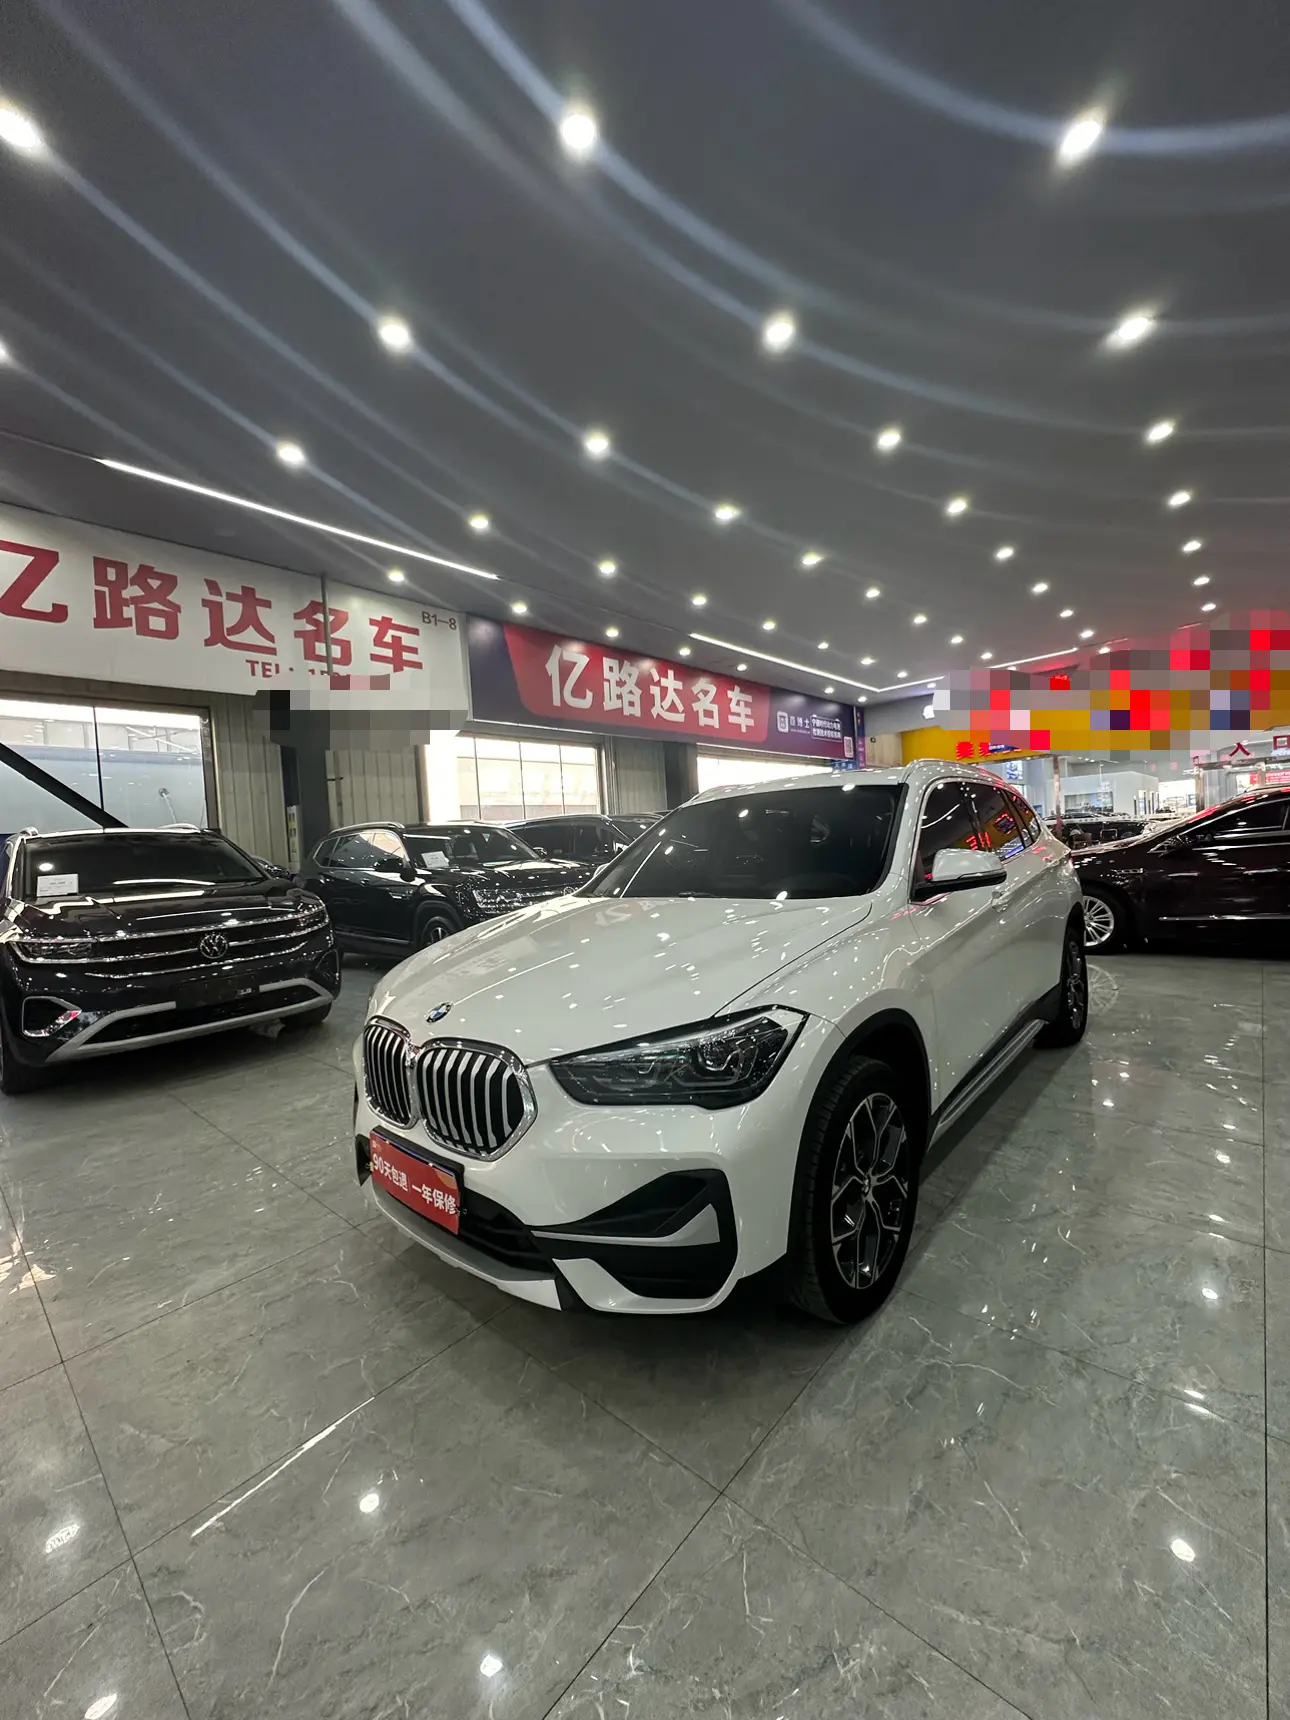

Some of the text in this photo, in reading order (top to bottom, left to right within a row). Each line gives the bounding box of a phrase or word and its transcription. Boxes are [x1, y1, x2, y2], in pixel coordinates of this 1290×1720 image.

[545, 644, 755, 733] 亿路达名车
[372, 1153, 456, 1215] 90天包退 一年保修
